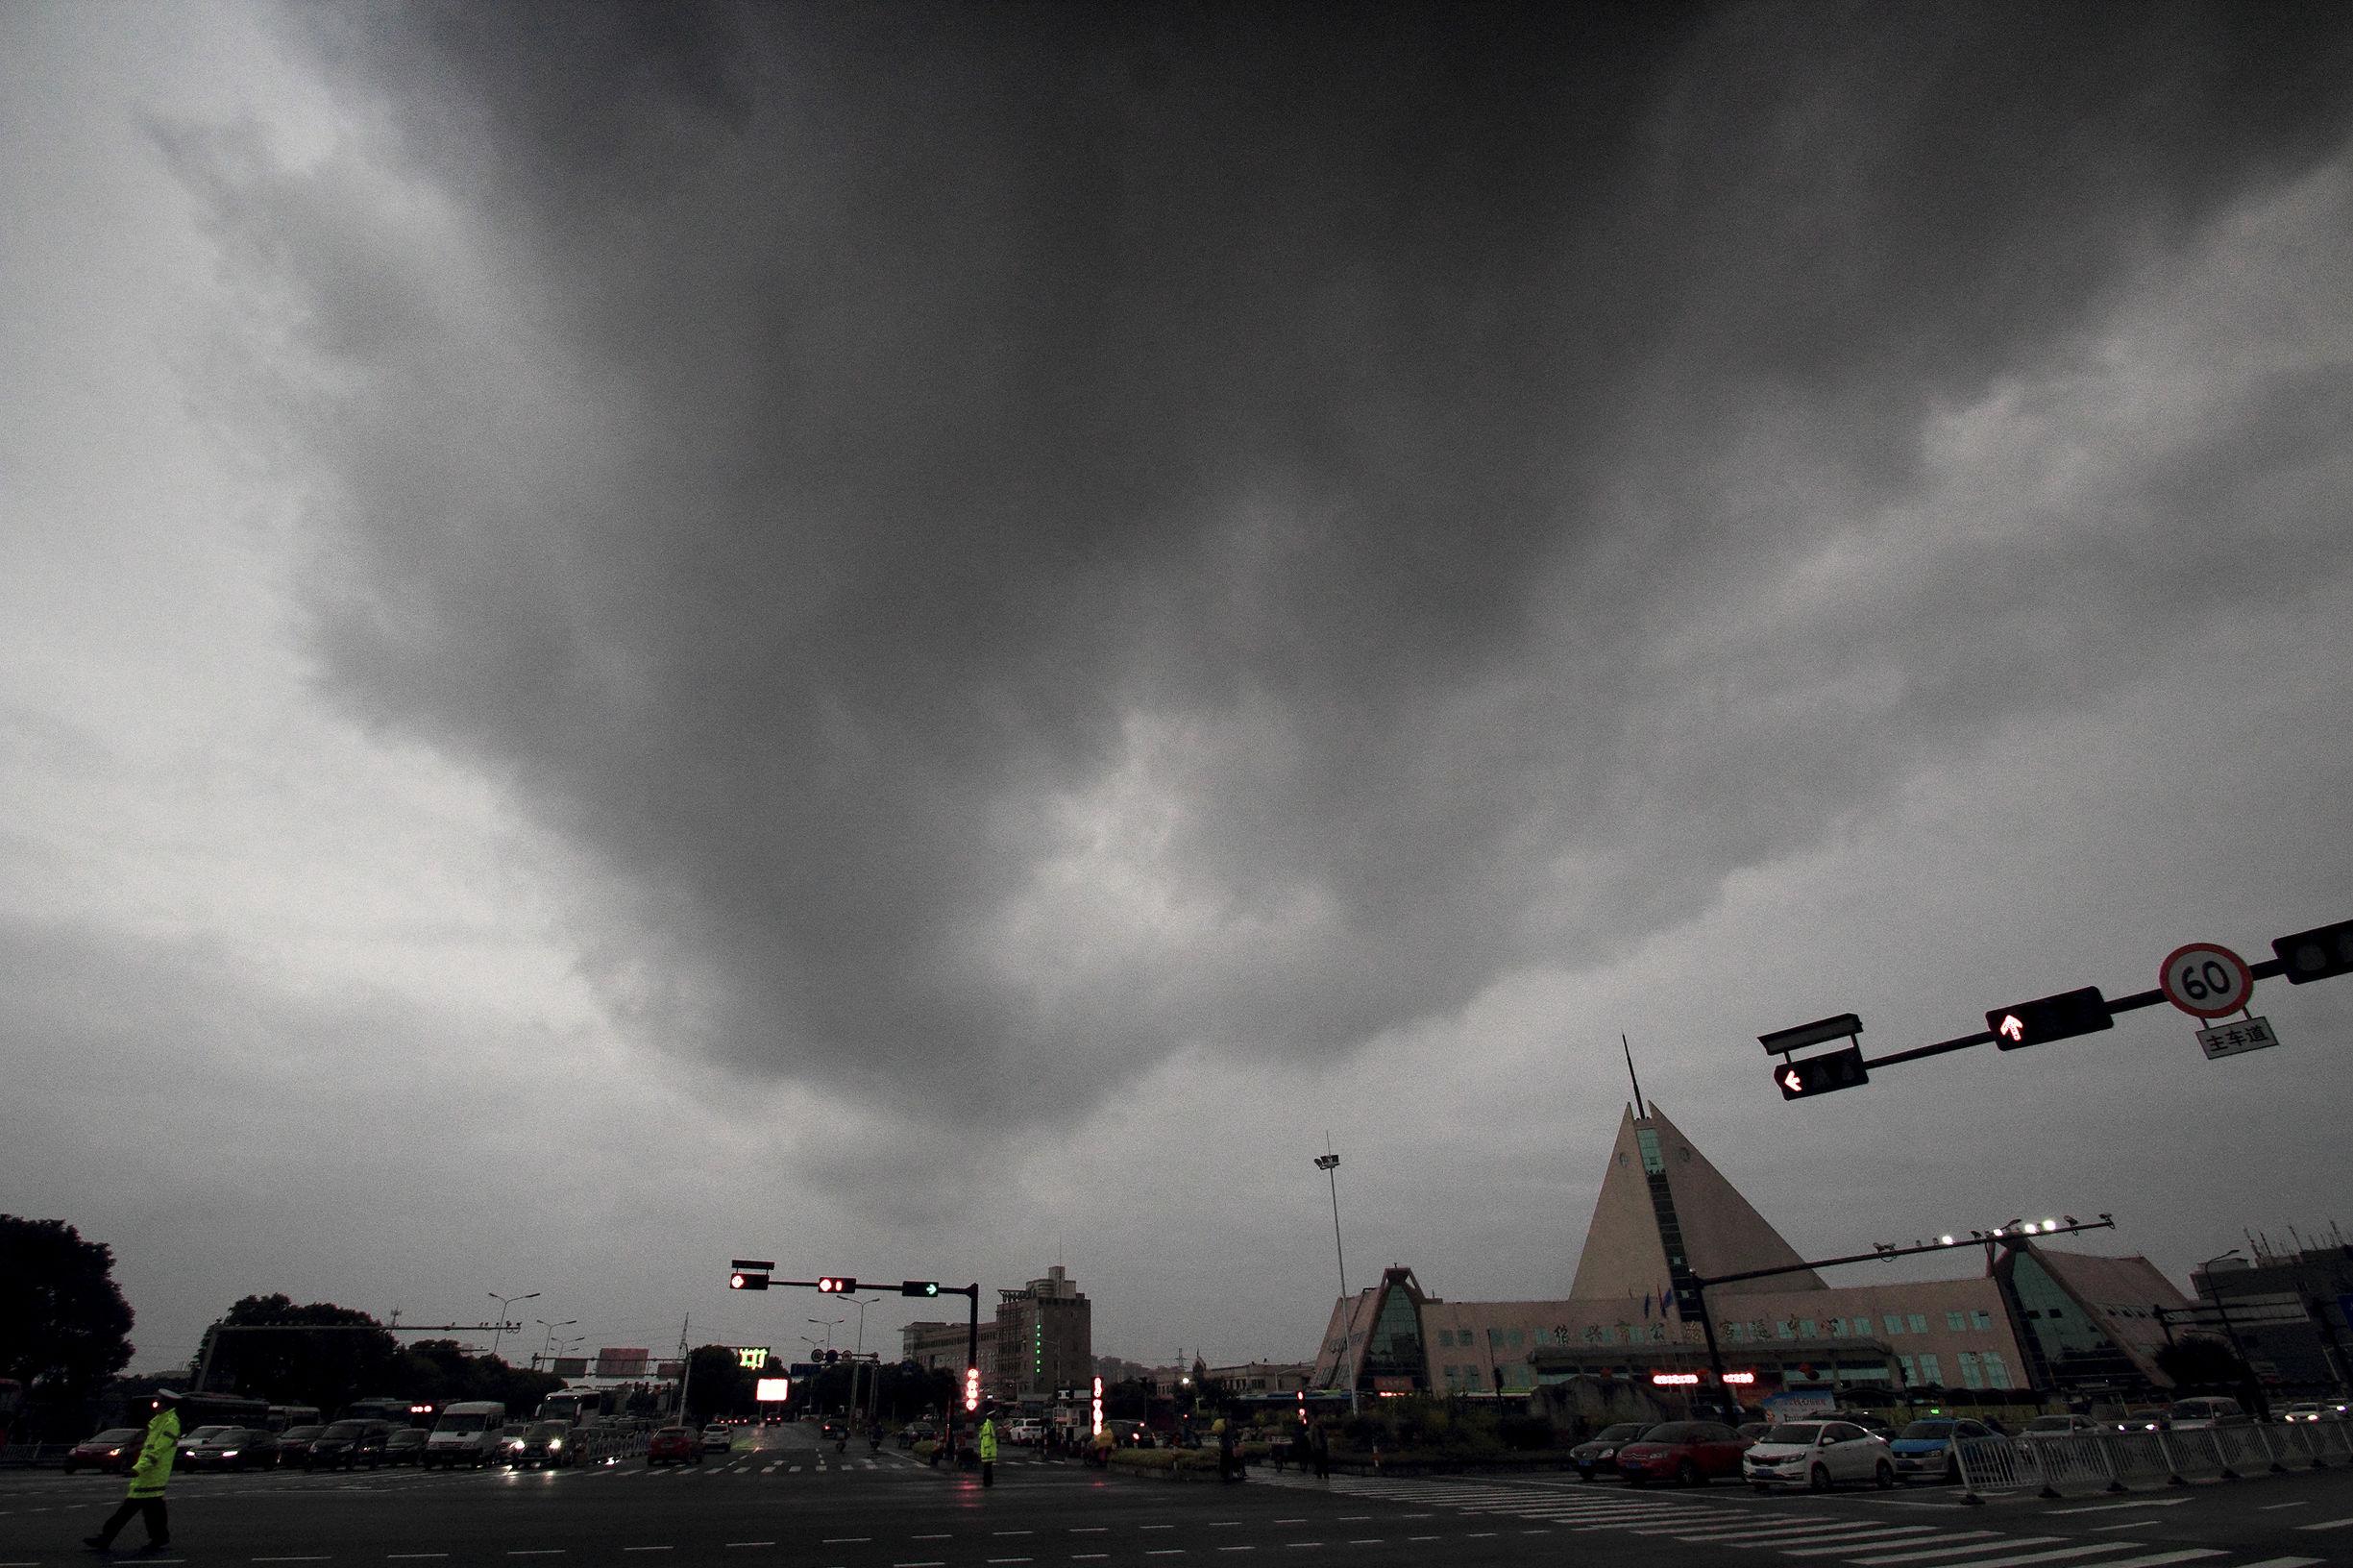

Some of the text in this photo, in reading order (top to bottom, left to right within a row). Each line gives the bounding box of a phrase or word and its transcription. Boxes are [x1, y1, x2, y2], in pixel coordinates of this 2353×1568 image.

[2181, 961, 2230, 1000] 60
[2206, 1024, 2268, 1051] 主车道
